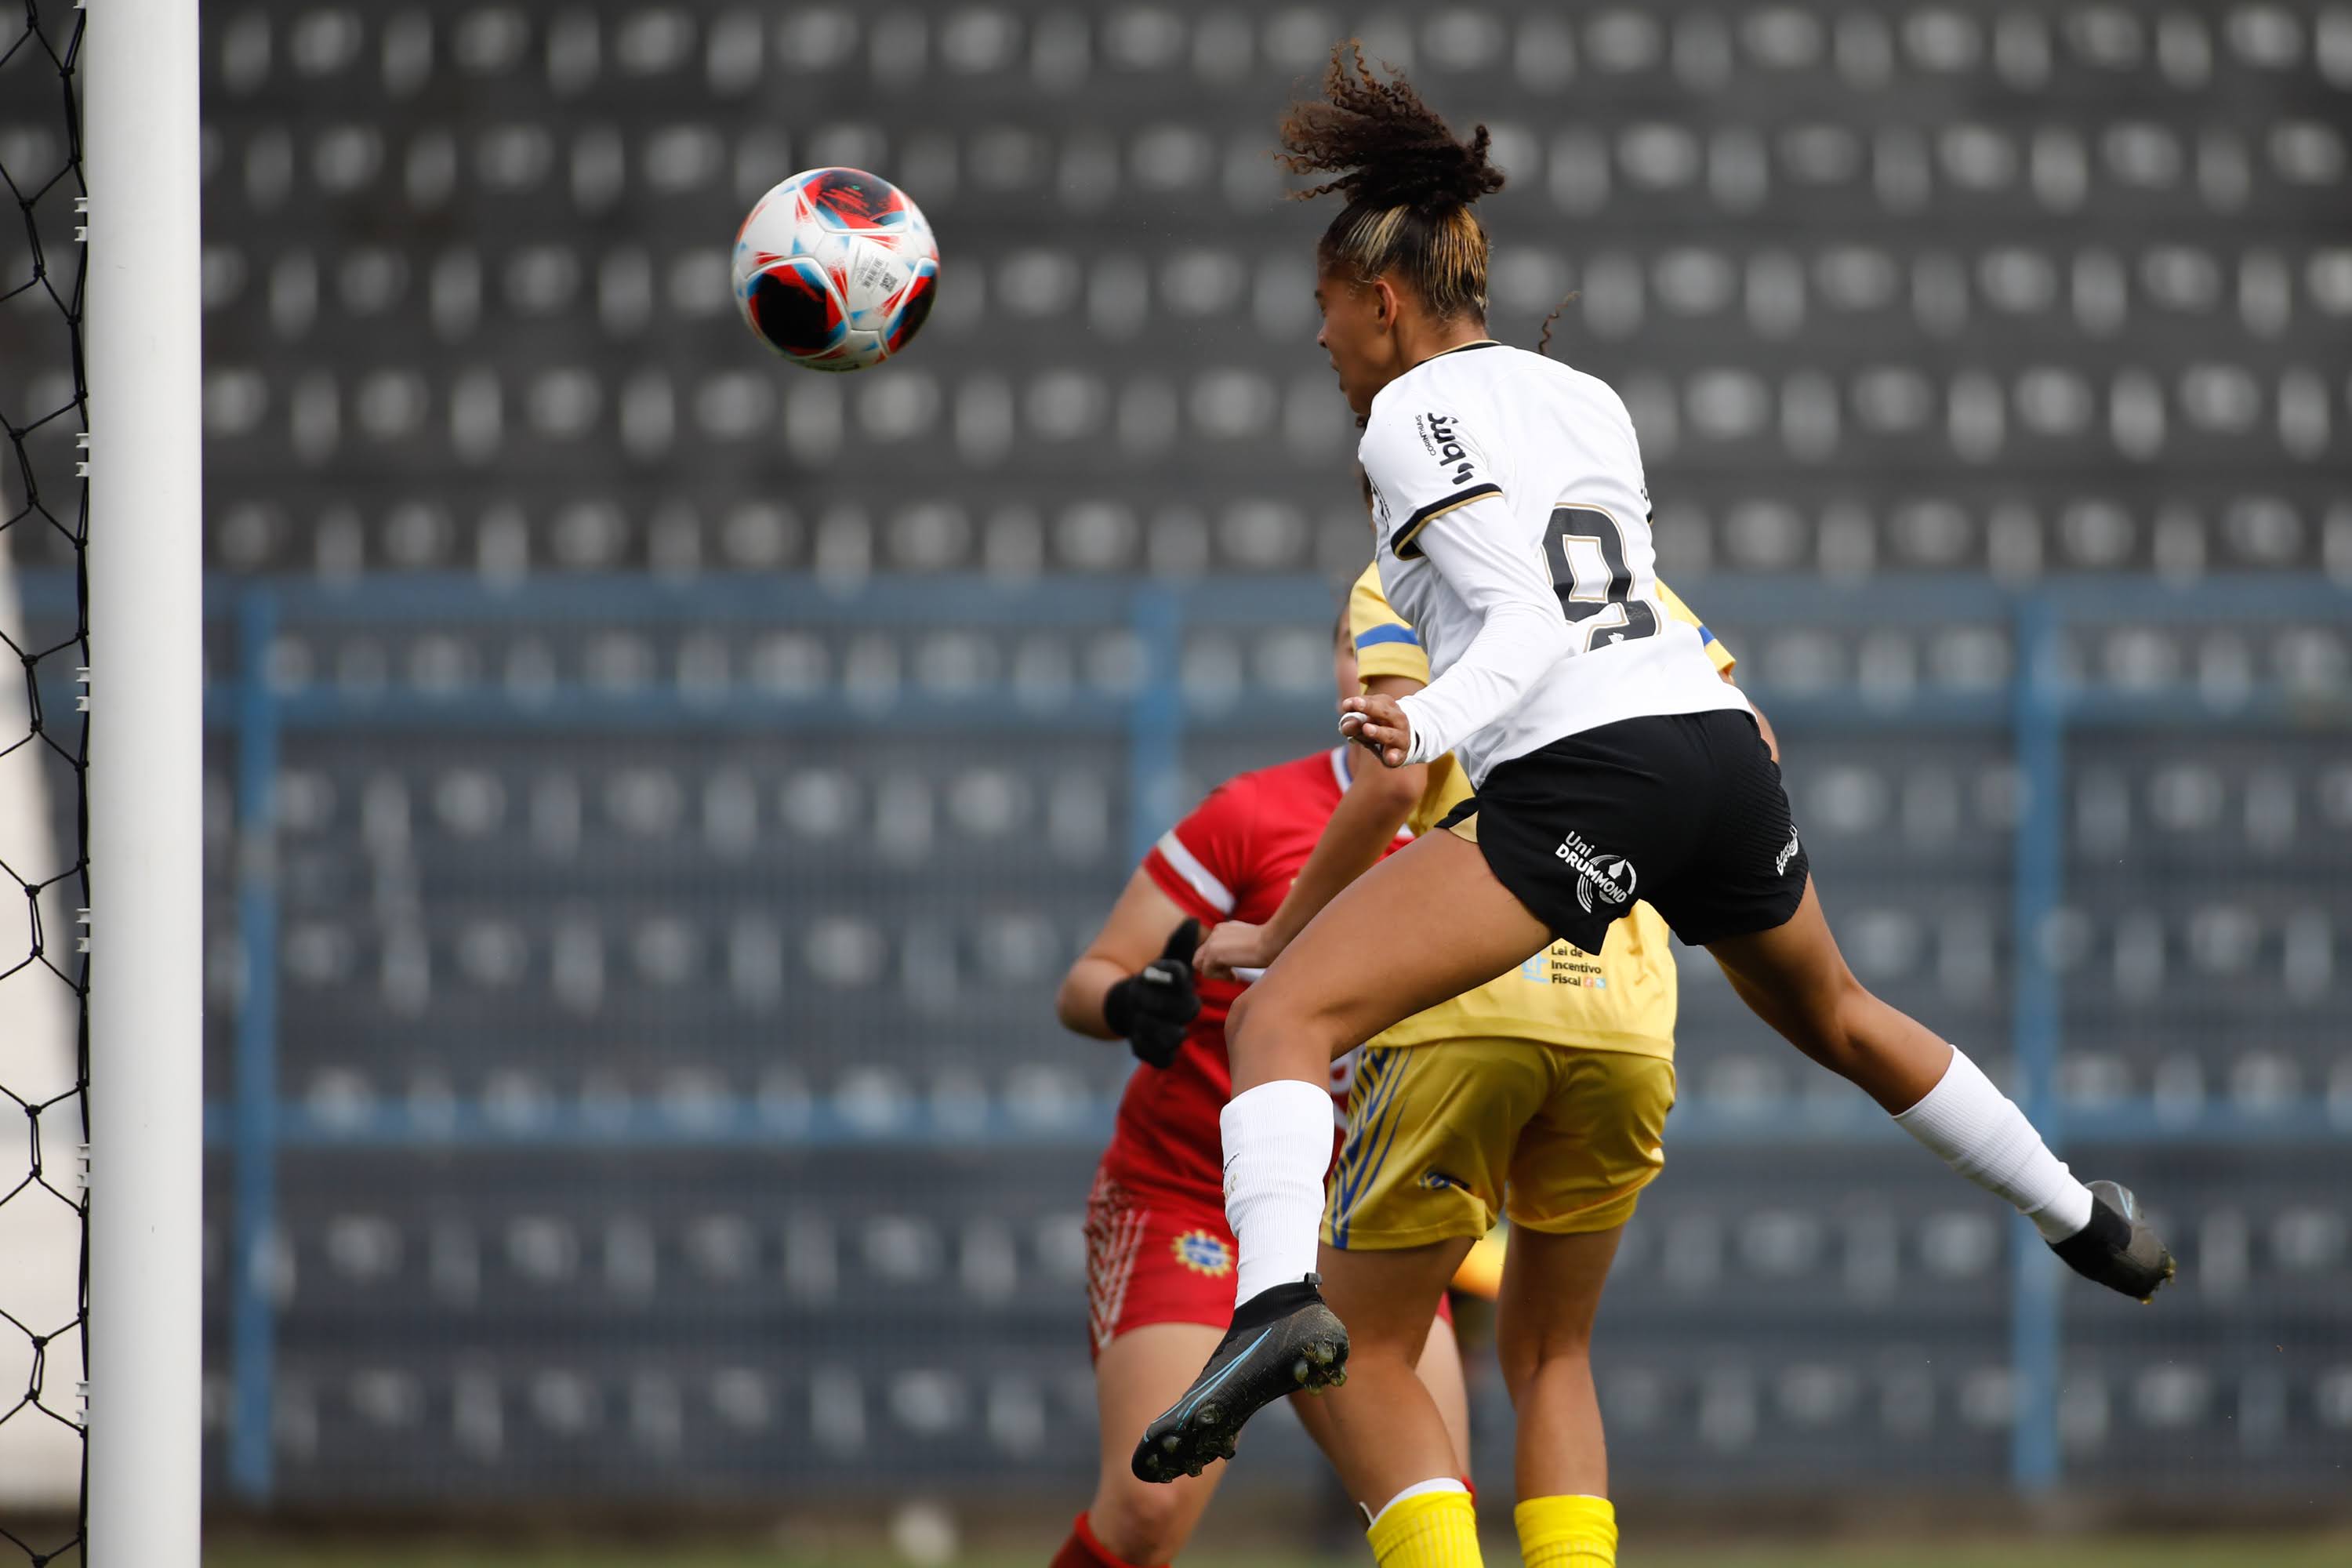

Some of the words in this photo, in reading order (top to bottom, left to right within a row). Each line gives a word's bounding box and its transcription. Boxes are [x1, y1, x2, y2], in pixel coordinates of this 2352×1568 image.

[1414, 414, 1436, 456] CORINTHIANS
[1539, 502, 1662, 654] 9
[1566, 830, 1595, 858] Uni
[1555, 843, 1628, 903] DRUMMOND
[1551, 945, 1568, 956] Lei
[1570, 946, 1584, 957] de
[1551, 959, 1602, 975] Incentivo
[1552, 973, 1581, 987] Fiscal
